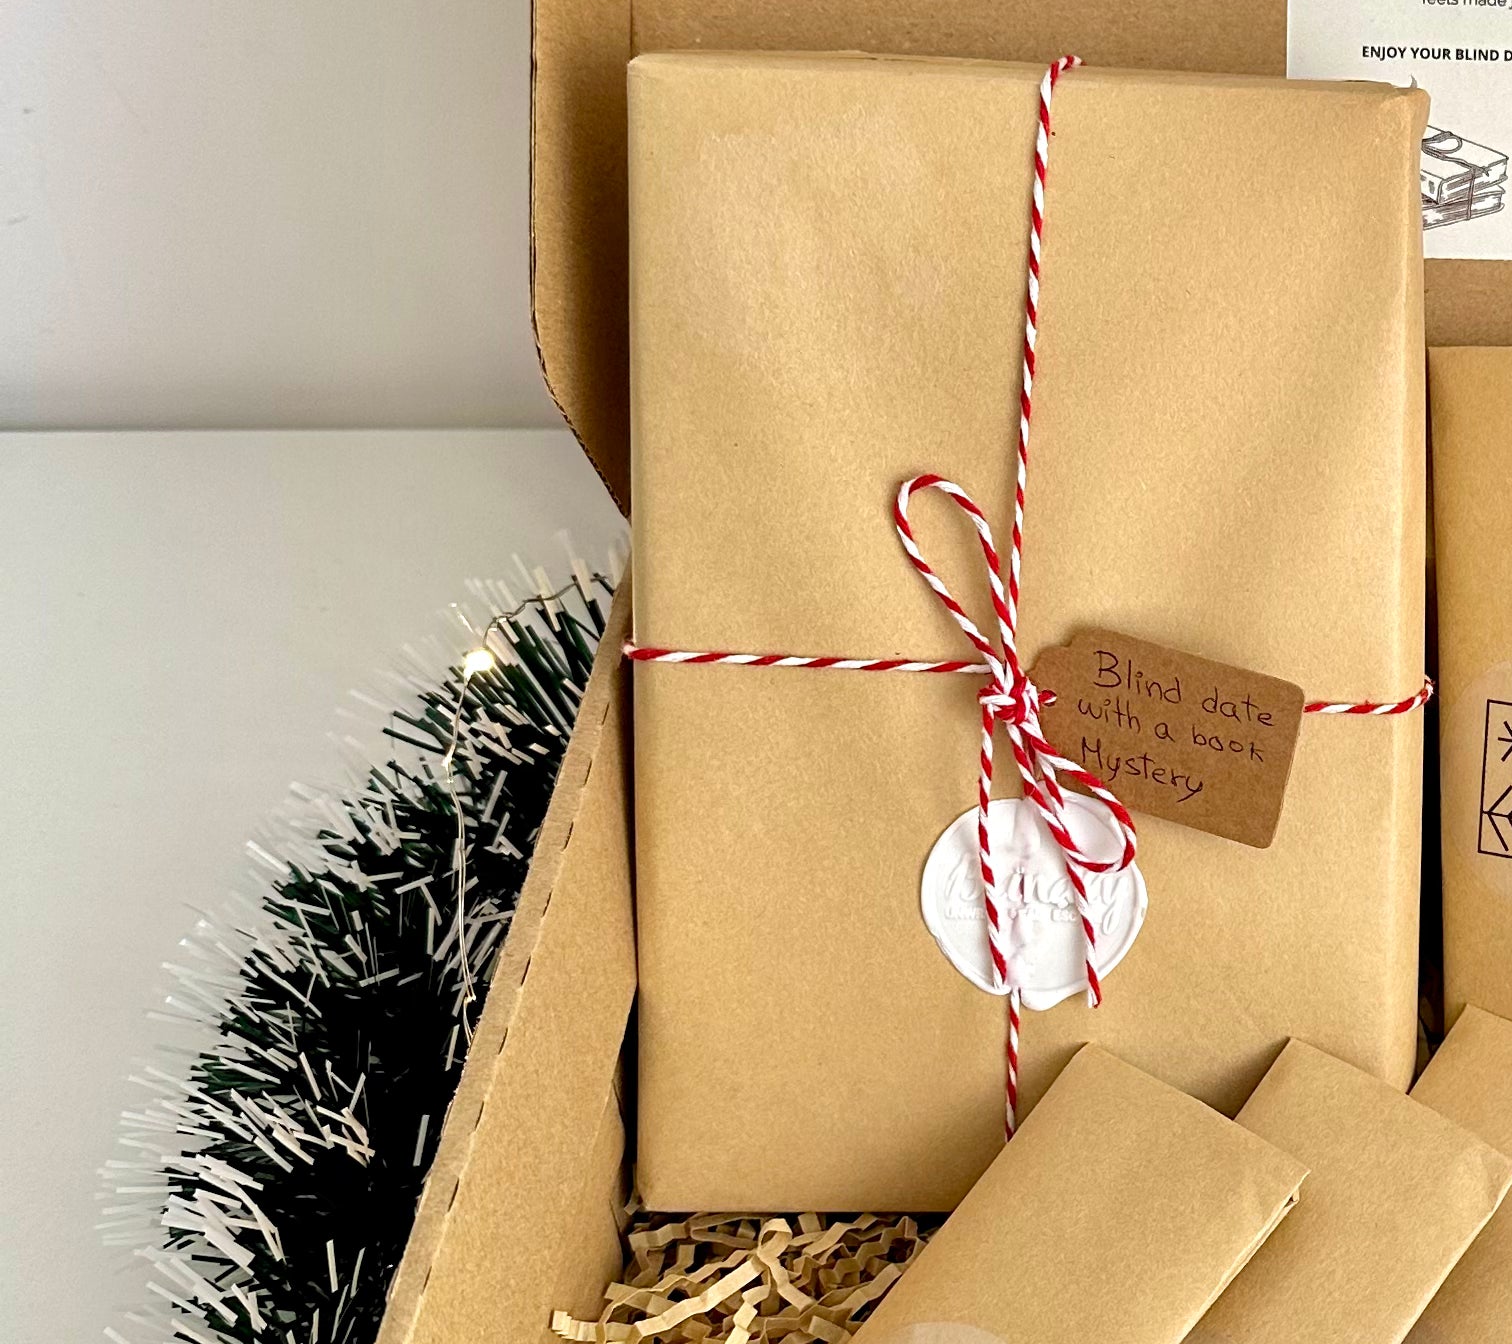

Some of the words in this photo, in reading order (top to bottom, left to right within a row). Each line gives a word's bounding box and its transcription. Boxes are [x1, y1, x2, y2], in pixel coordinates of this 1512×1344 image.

[1361, 45, 1407, 62] ENJOY
[1410, 47, 1452, 62] YOUR
[1455, 48, 1500, 63] BLIND
[1092, 649, 1182, 705] Blind
[1201, 686, 1275, 727] date
[1077, 695, 1142, 734] with
[1153, 721, 1176, 744] a
[1191, 723, 1264, 763] book
[1080, 735, 1204, 804] Mystery
